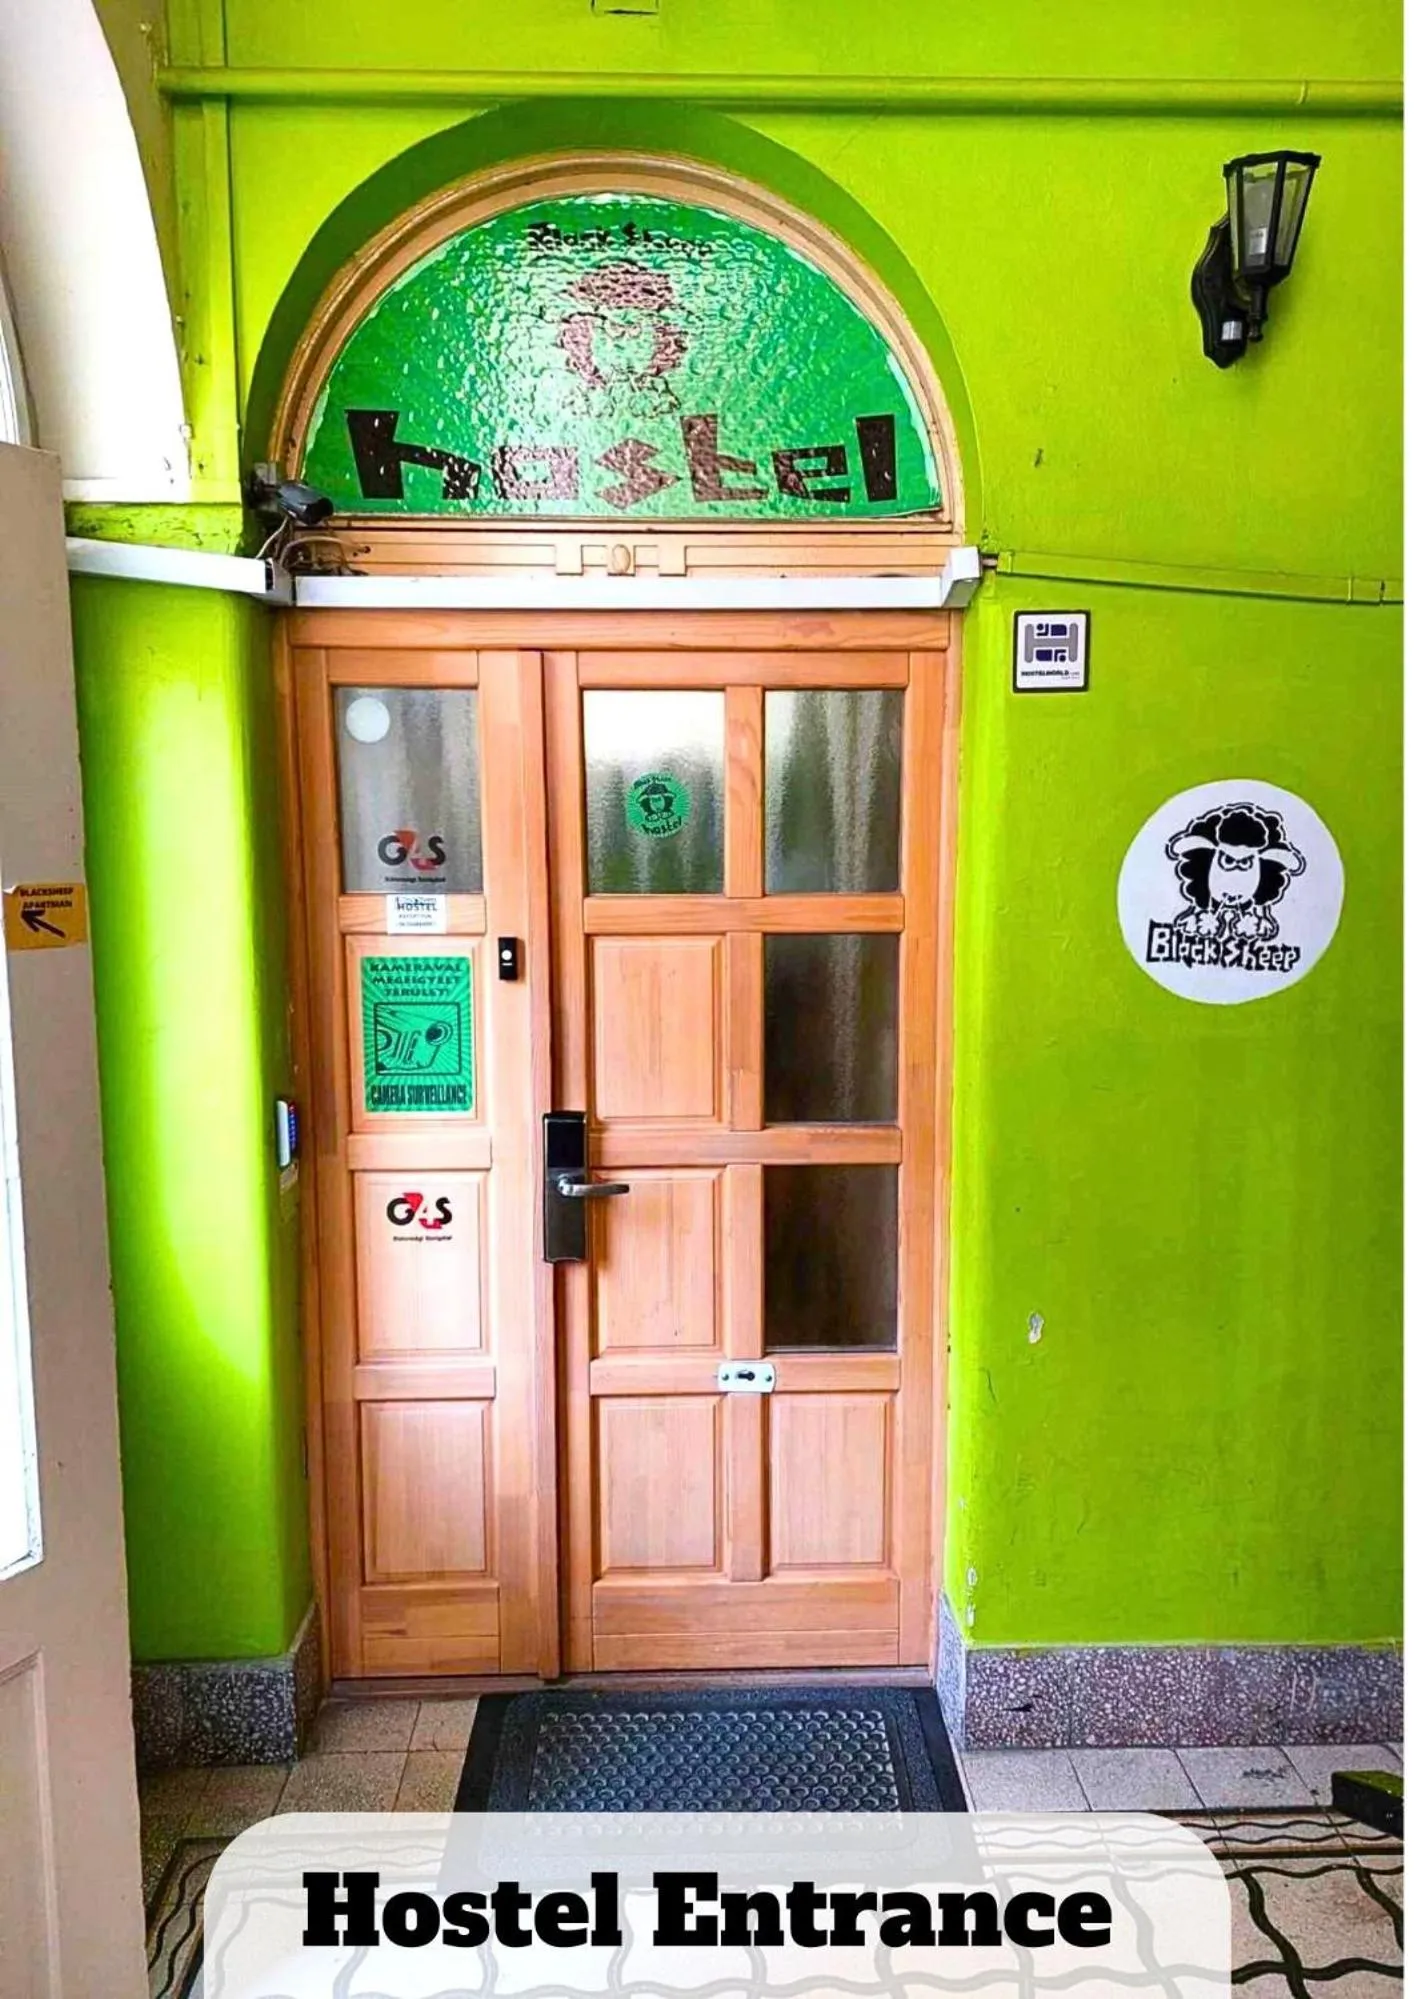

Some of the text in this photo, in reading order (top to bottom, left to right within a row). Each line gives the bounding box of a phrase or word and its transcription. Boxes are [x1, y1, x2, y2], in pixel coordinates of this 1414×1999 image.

[345, 409, 898, 508] hostel
[377, 830, 446, 871] G4S
[1146, 919, 1300, 973] Black Sheep
[371, 1085, 466, 1105] CAMERA SURVEILLANCE
[386, 1192, 453, 1229] G4S
